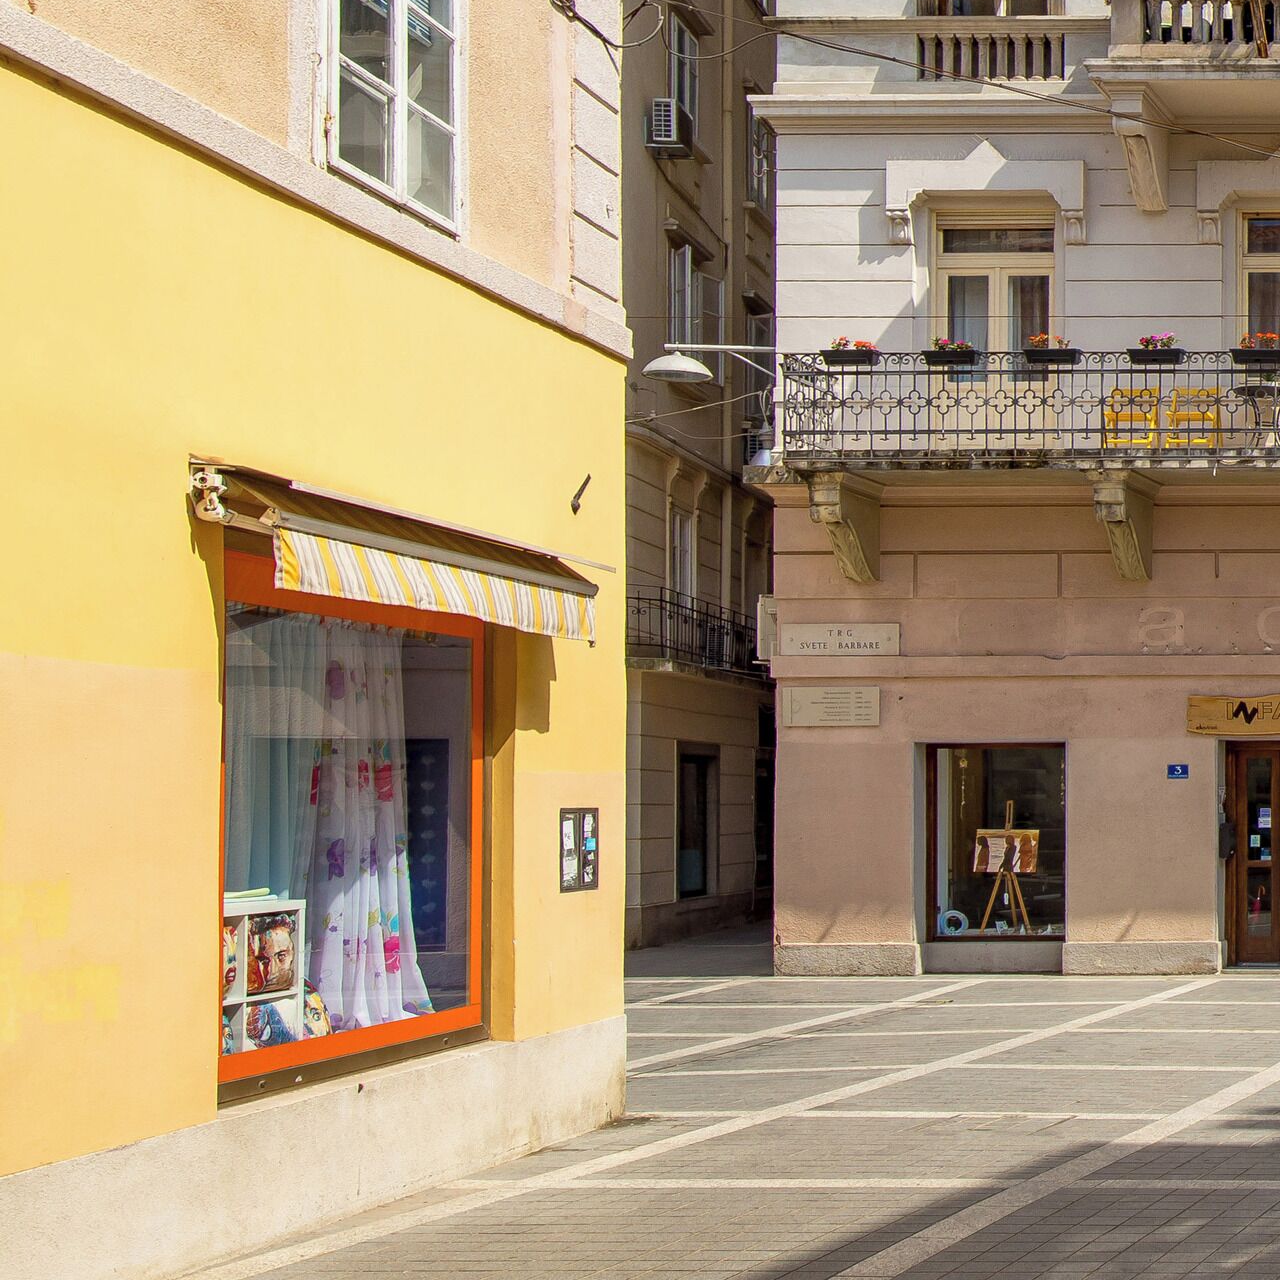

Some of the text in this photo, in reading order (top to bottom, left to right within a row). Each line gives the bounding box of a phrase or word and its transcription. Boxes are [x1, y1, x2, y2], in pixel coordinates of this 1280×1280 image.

[827, 629, 853, 637] TRG
[799, 641, 880, 650] SVETE BARBARE
[1174, 766, 1182, 775] 3
